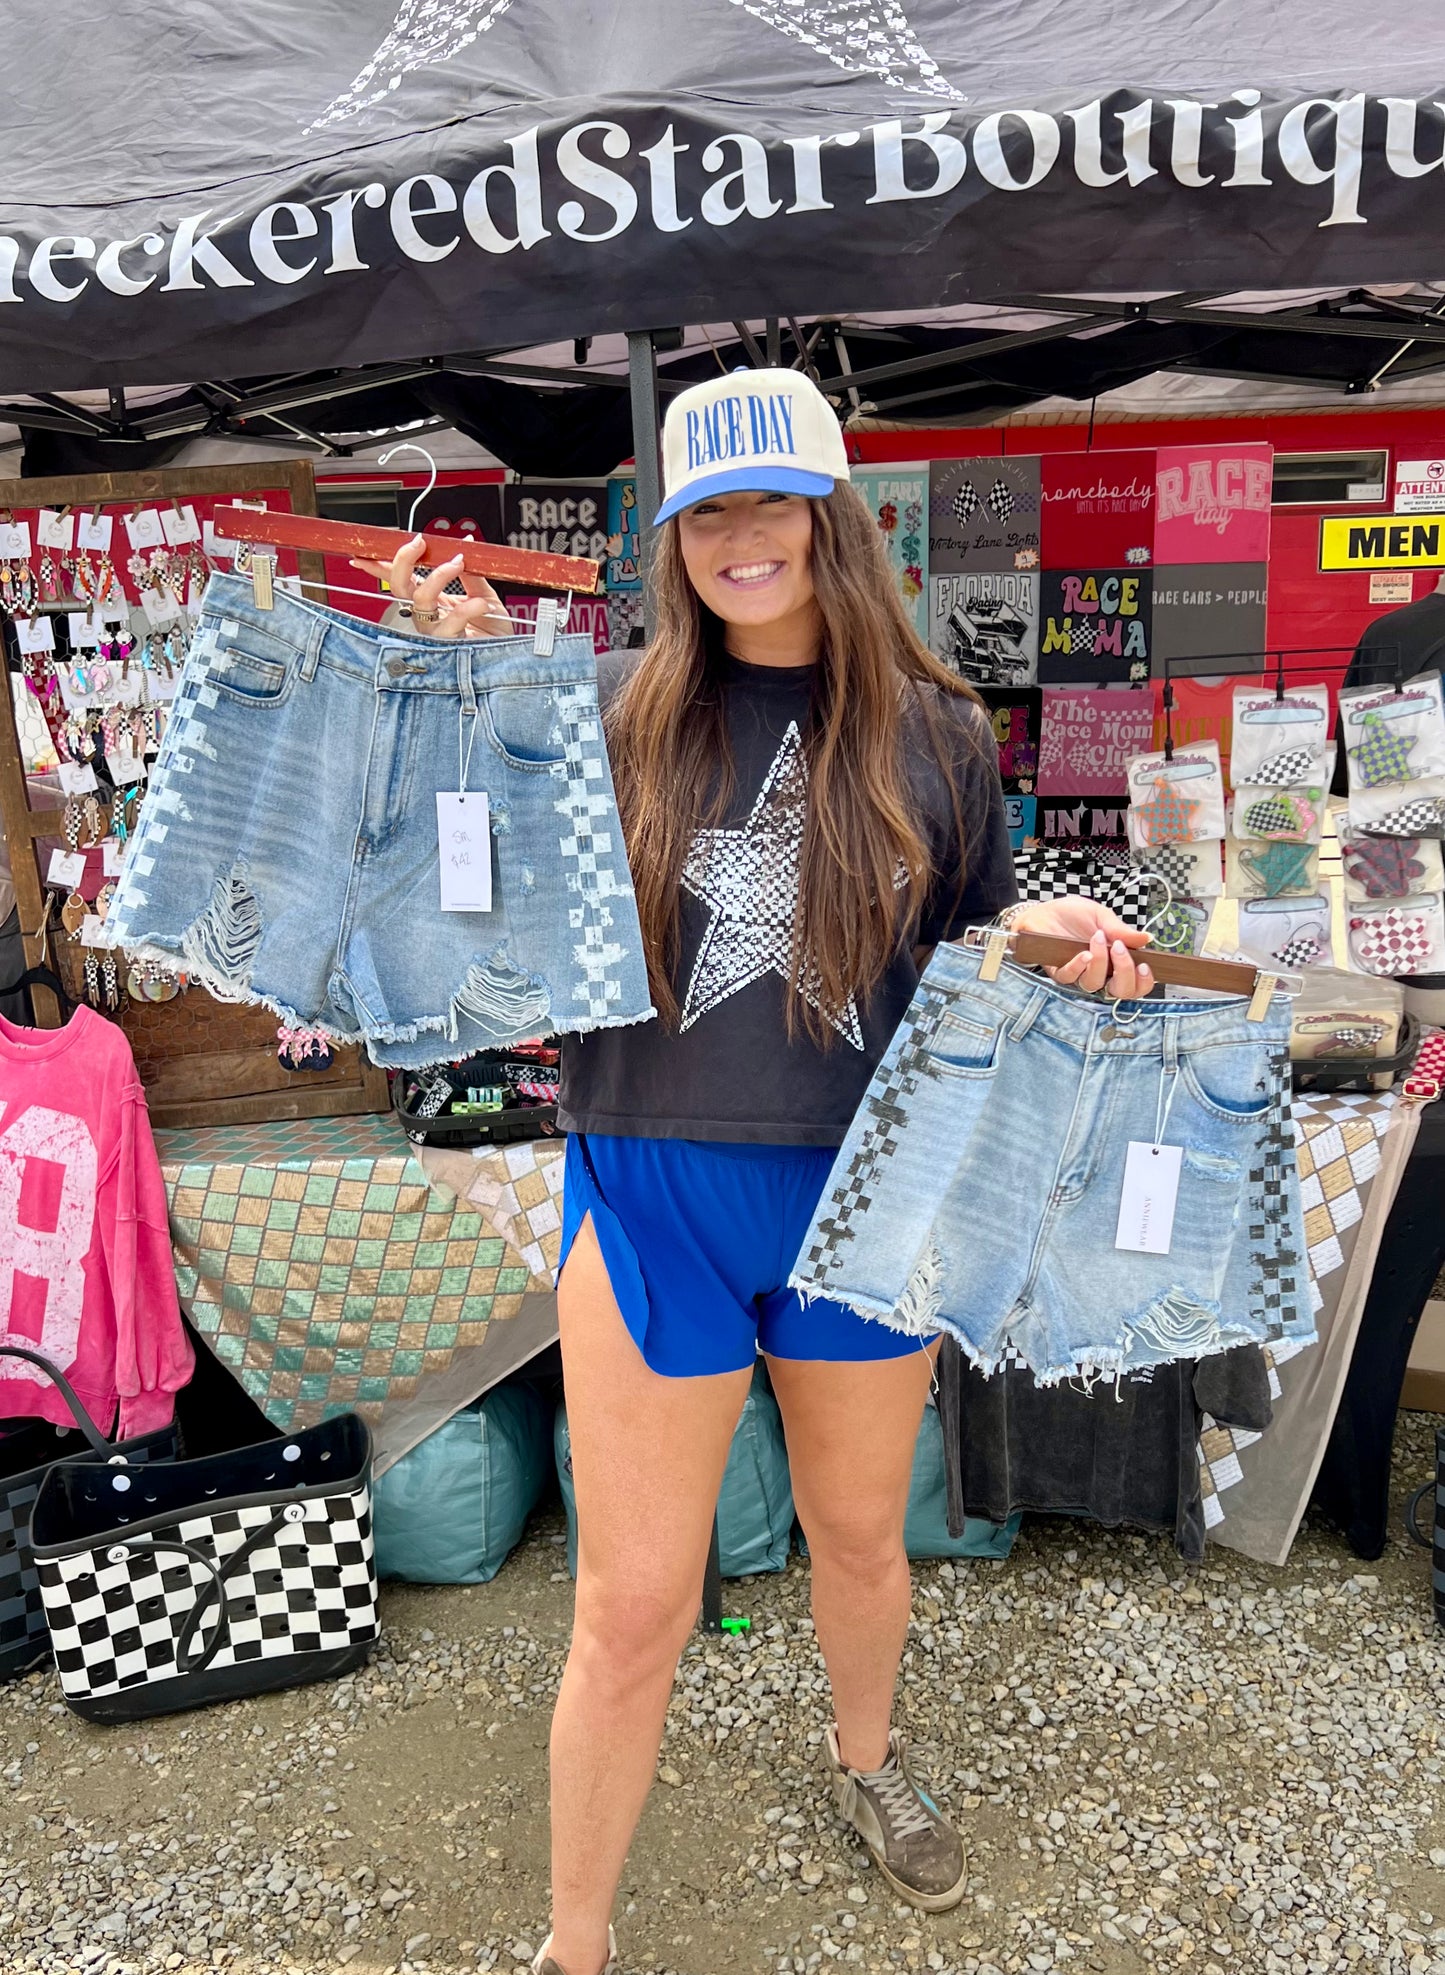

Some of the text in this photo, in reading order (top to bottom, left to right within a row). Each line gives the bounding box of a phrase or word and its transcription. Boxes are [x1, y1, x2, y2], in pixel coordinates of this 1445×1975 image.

[685, 394, 798, 471] RACE DAY
[1041, 477, 1156, 509] homebody
[1156, 459, 1272, 523] RACE
[1193, 495, 1234, 535] day
[1348, 525, 1440, 559] MEN
[937, 575, 1034, 617] FLORIDA
[1060, 575, 1140, 616] RACE
[1182, 590, 1212, 605] CARS
[1050, 699, 1098, 723] The
[1041, 717, 1092, 740] Race
[1099, 720, 1153, 750] Mom
[1043, 809, 1081, 838] IN
